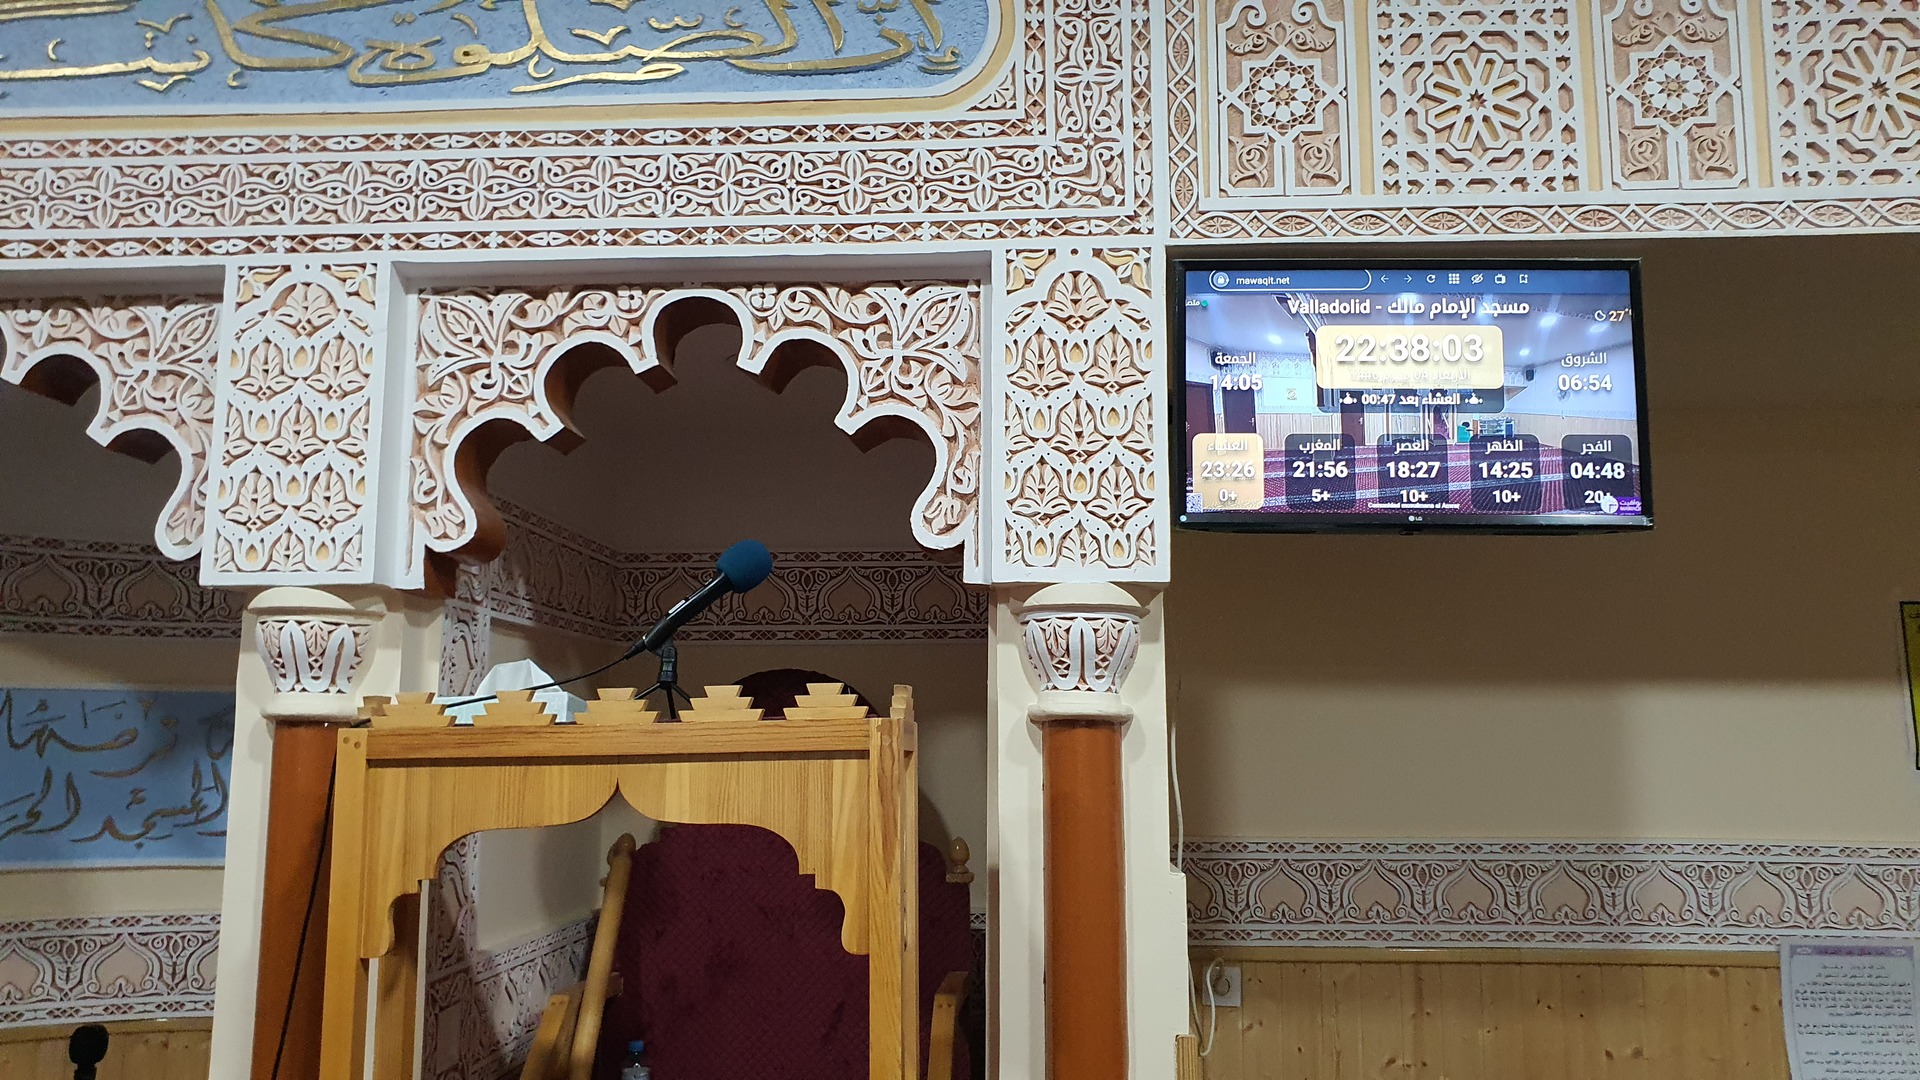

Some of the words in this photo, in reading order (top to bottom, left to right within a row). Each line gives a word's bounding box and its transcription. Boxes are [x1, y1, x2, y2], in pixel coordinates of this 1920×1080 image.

[1236, 276, 1290, 286] mawaqit.net
[1287, 298, 1371, 315] Valladolid
[1387, 298, 1425, 314] مالك
[1429, 298, 1476, 319] الإمام
[1481, 300, 1530, 317] مسجد
[1334, 333, 1484, 363] 22:38:03
[1214, 351, 1256, 366] الجمعة
[1561, 352, 1607, 368] الشروق
[1210, 374, 1263, 391] 14:05
[1558, 374, 1613, 391] 06:54
[1361, 394, 1396, 405] 00:47
[1398, 394, 1419, 407] بعد
[1421, 393, 1461, 405] العشاء
[1207, 439, 1248, 451] العشاء
[1299, 438, 1341, 455] المغرب
[1394, 438, 1430, 455] العصر
[1485, 438, 1523, 455] الظهر
[1580, 439, 1612, 455] الفجر
[1200, 460, 1256, 478] 23:26
[1292, 460, 1348, 478] 21:56
[1386, 461, 1441, 478] 18:27
[1478, 461, 1534, 479] 14:25
[1570, 462, 1625, 479] 04:48
[1218, 488, 1238, 502] 0+
[1311, 488, 1331, 502] 5+
[1400, 489, 1429, 503] 10+
[1492, 489, 1521, 503] 10+
